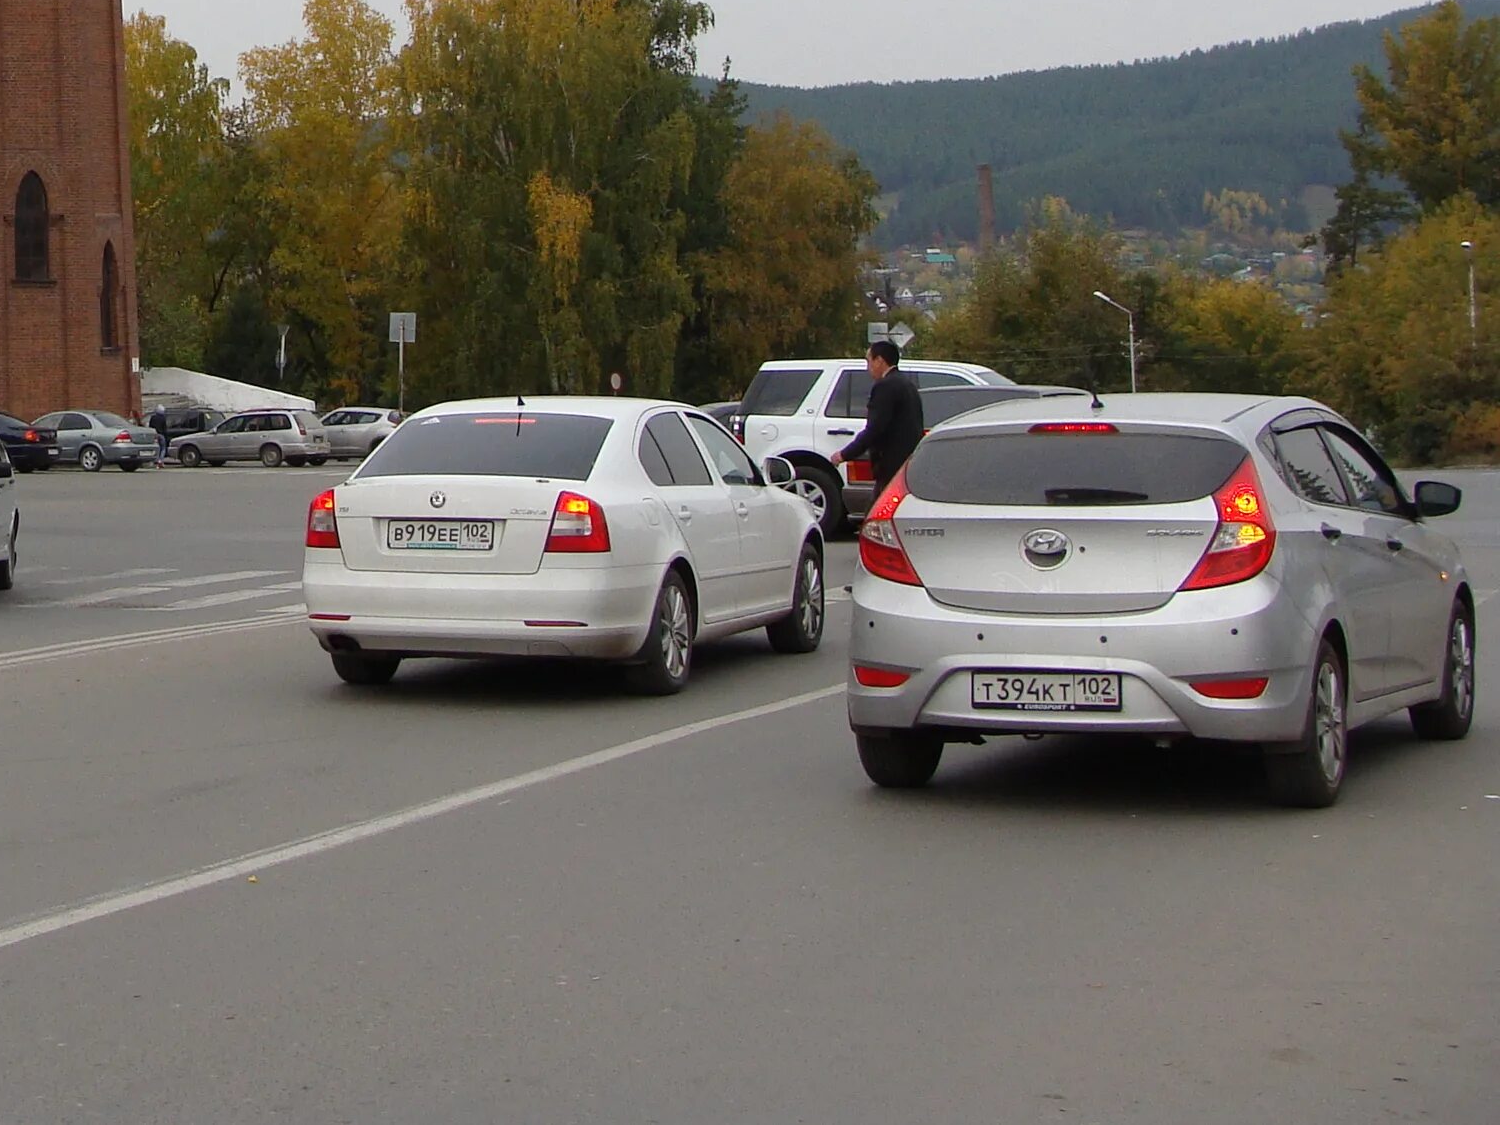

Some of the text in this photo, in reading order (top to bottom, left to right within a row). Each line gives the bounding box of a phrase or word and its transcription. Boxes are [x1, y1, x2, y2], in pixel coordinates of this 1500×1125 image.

[462, 523, 488, 539] 102
[981, 677, 1112, 702] Т394КТ 102
[1023, 703, 1067, 711] EUROSPORT
